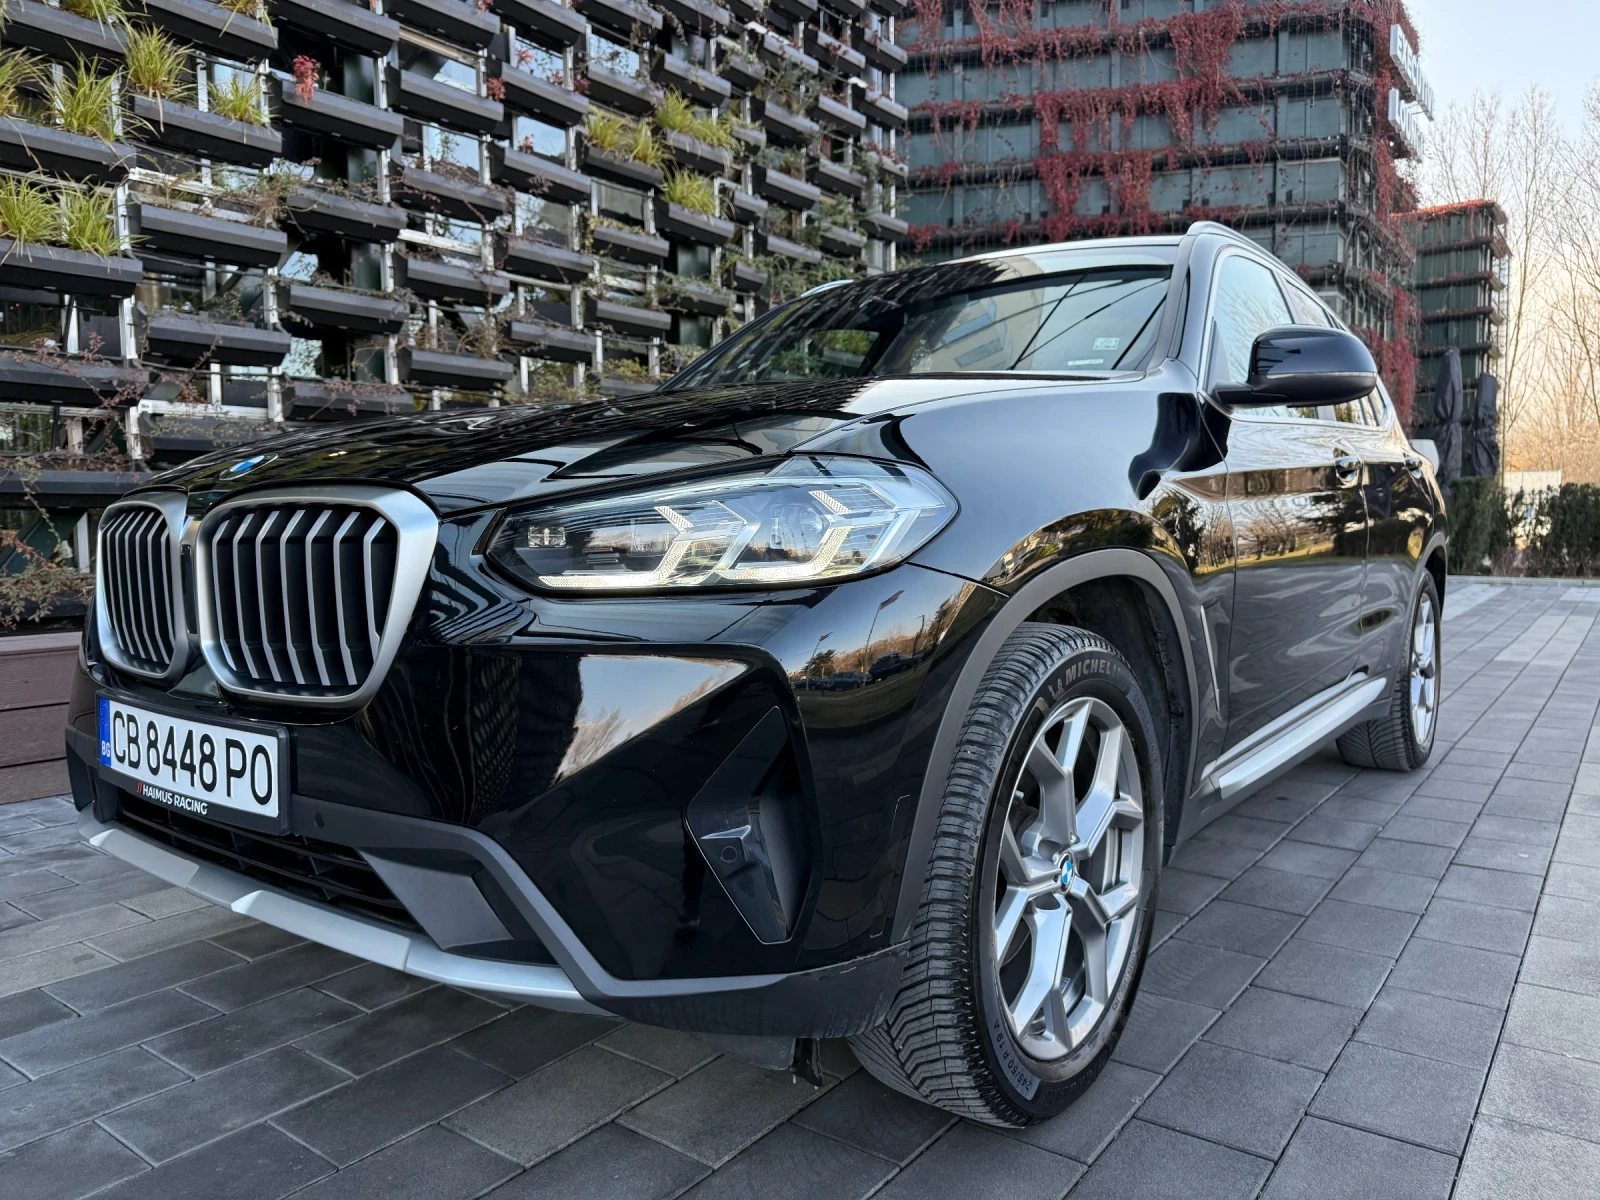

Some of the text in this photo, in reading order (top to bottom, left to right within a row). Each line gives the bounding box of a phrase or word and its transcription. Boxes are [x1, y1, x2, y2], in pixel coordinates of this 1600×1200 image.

[1391, 24, 1435, 120] EXECUTIVE
[1065, 658, 1125, 686] MICHELIN
[101, 740, 111, 758] BG
[113, 710, 273, 806] CB 8448 PO
[142, 783, 208, 815] HAIMUS RACING
[1007, 1059, 1032, 1091] 245/50
